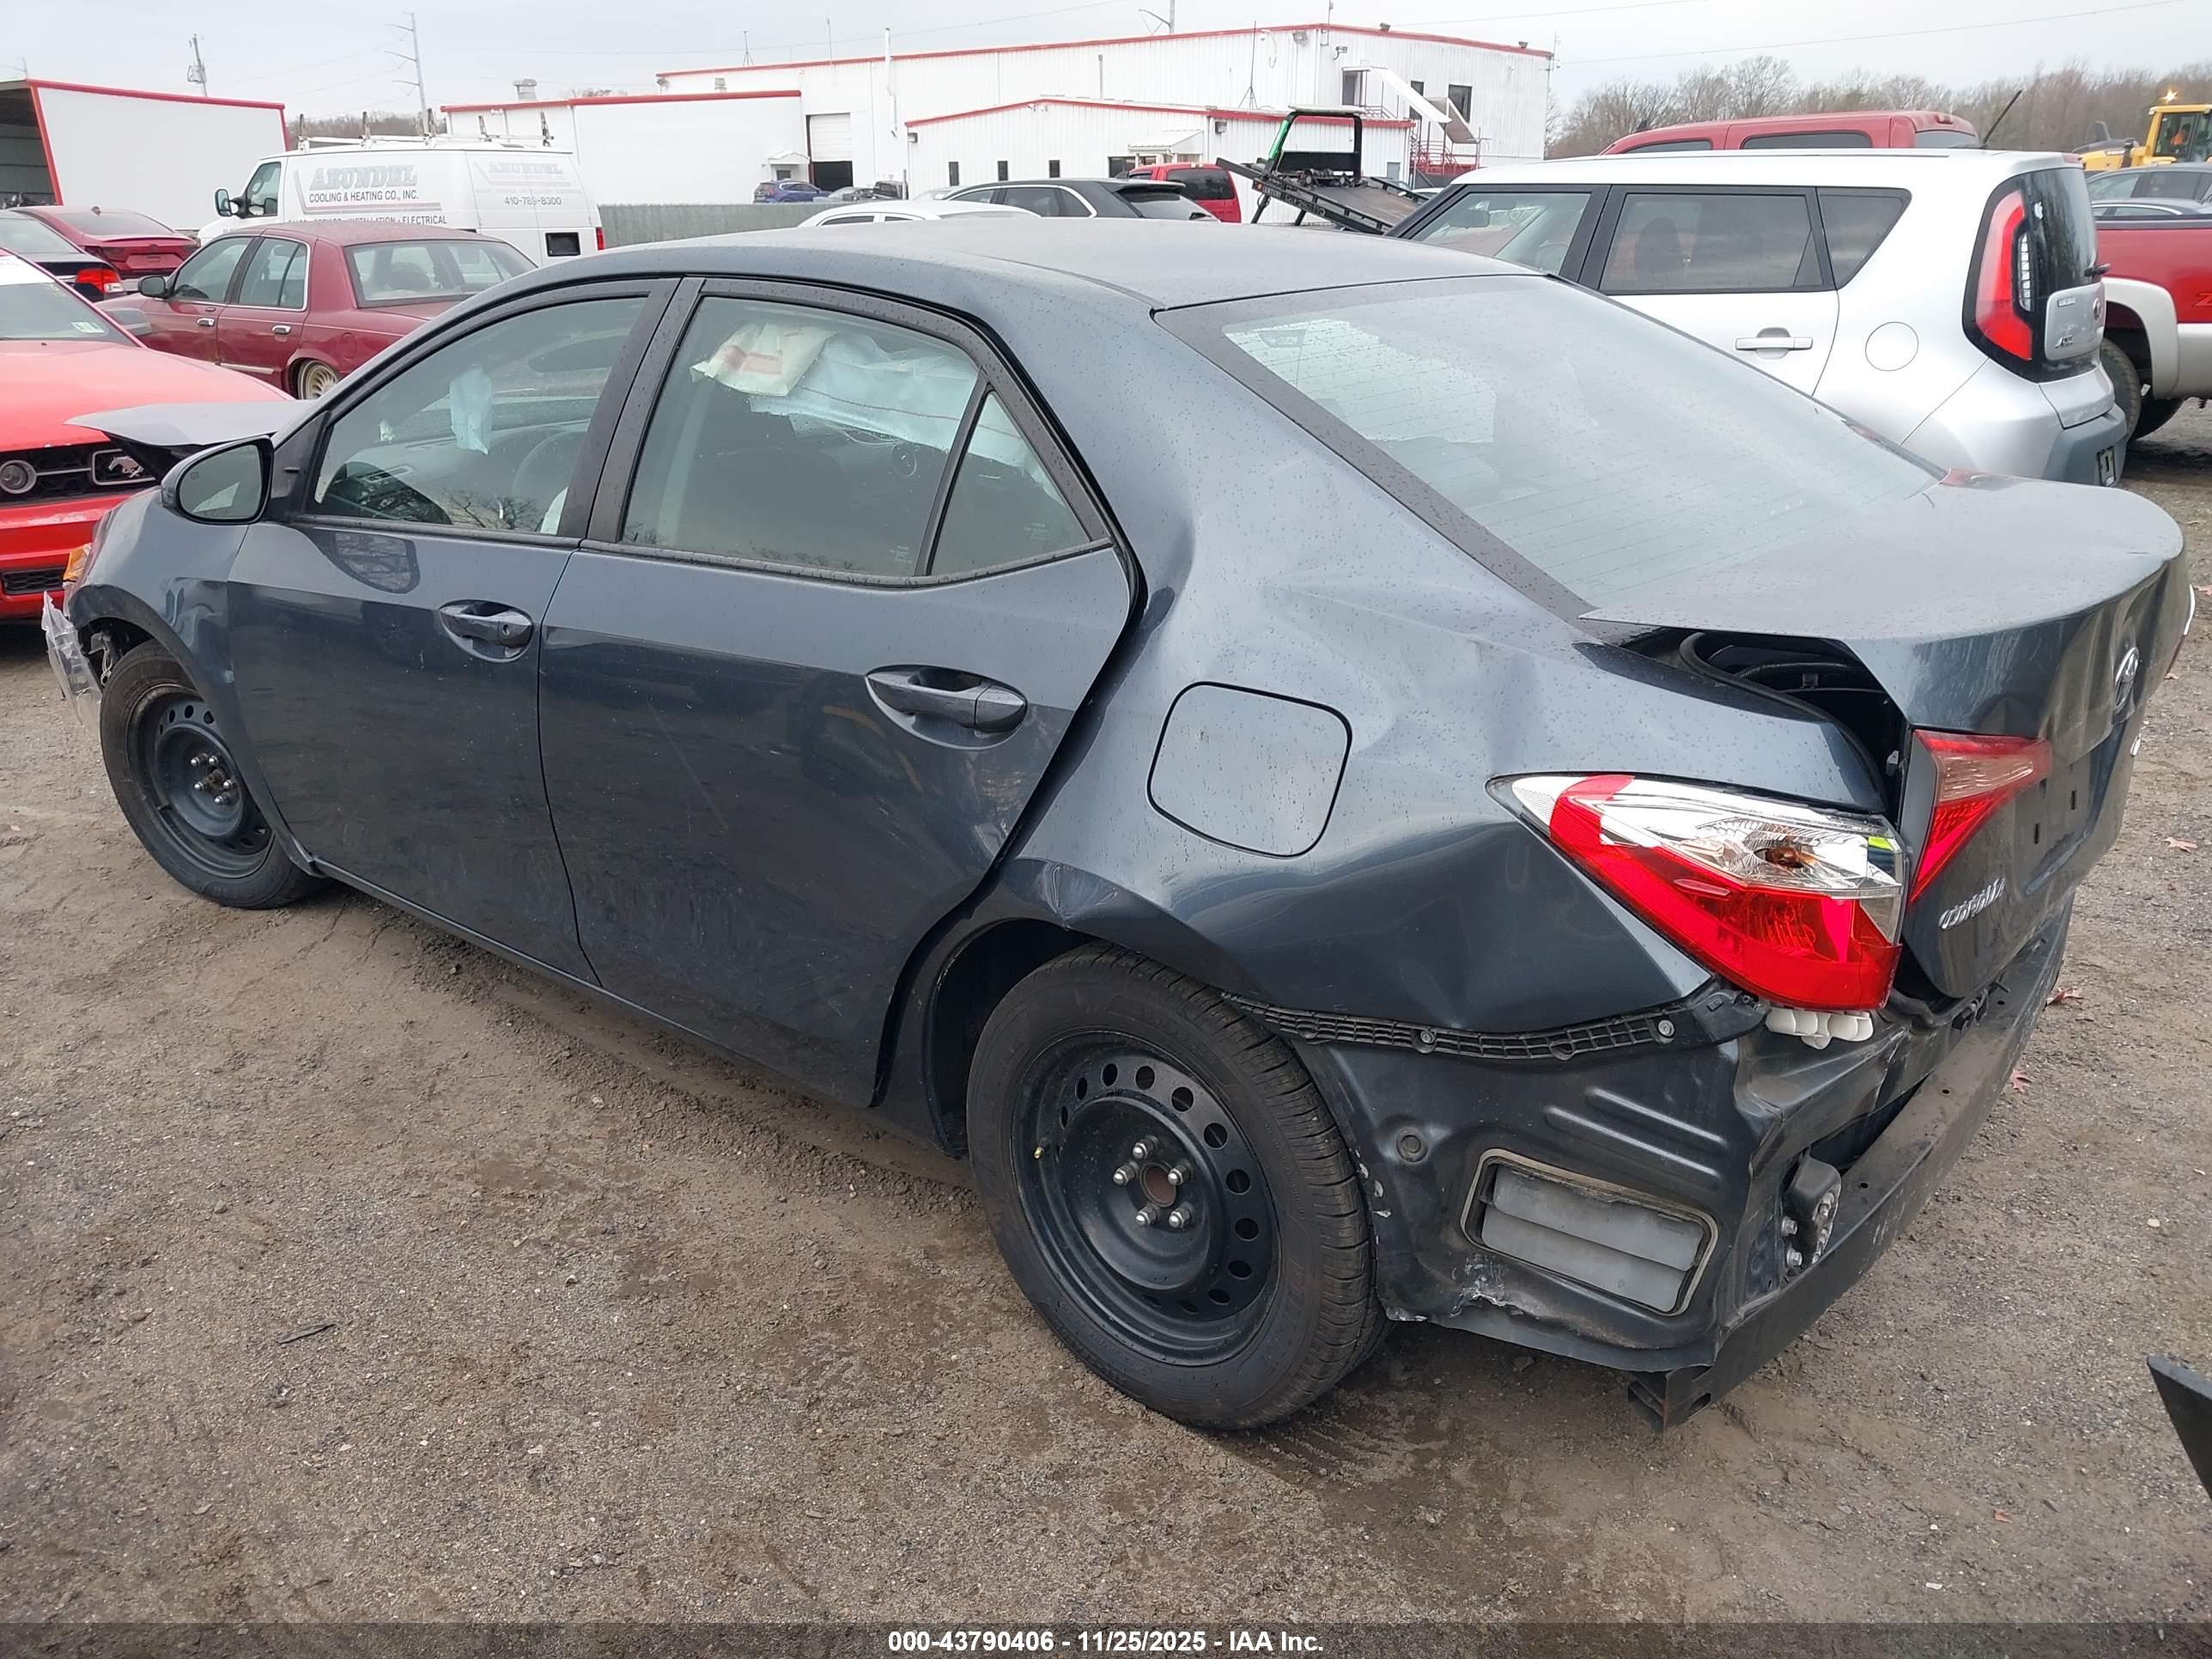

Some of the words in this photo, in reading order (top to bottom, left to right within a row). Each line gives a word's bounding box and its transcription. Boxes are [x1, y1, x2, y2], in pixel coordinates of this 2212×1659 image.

[309, 164, 418, 191] ARUNDEL
[309, 191, 342, 204] COOLING
[343, 192, 349, 202] &
[350, 191, 383, 202] HEATING
[403, 190, 419, 200] INC.
[402, 215, 447, 226] ELECTRICAL
